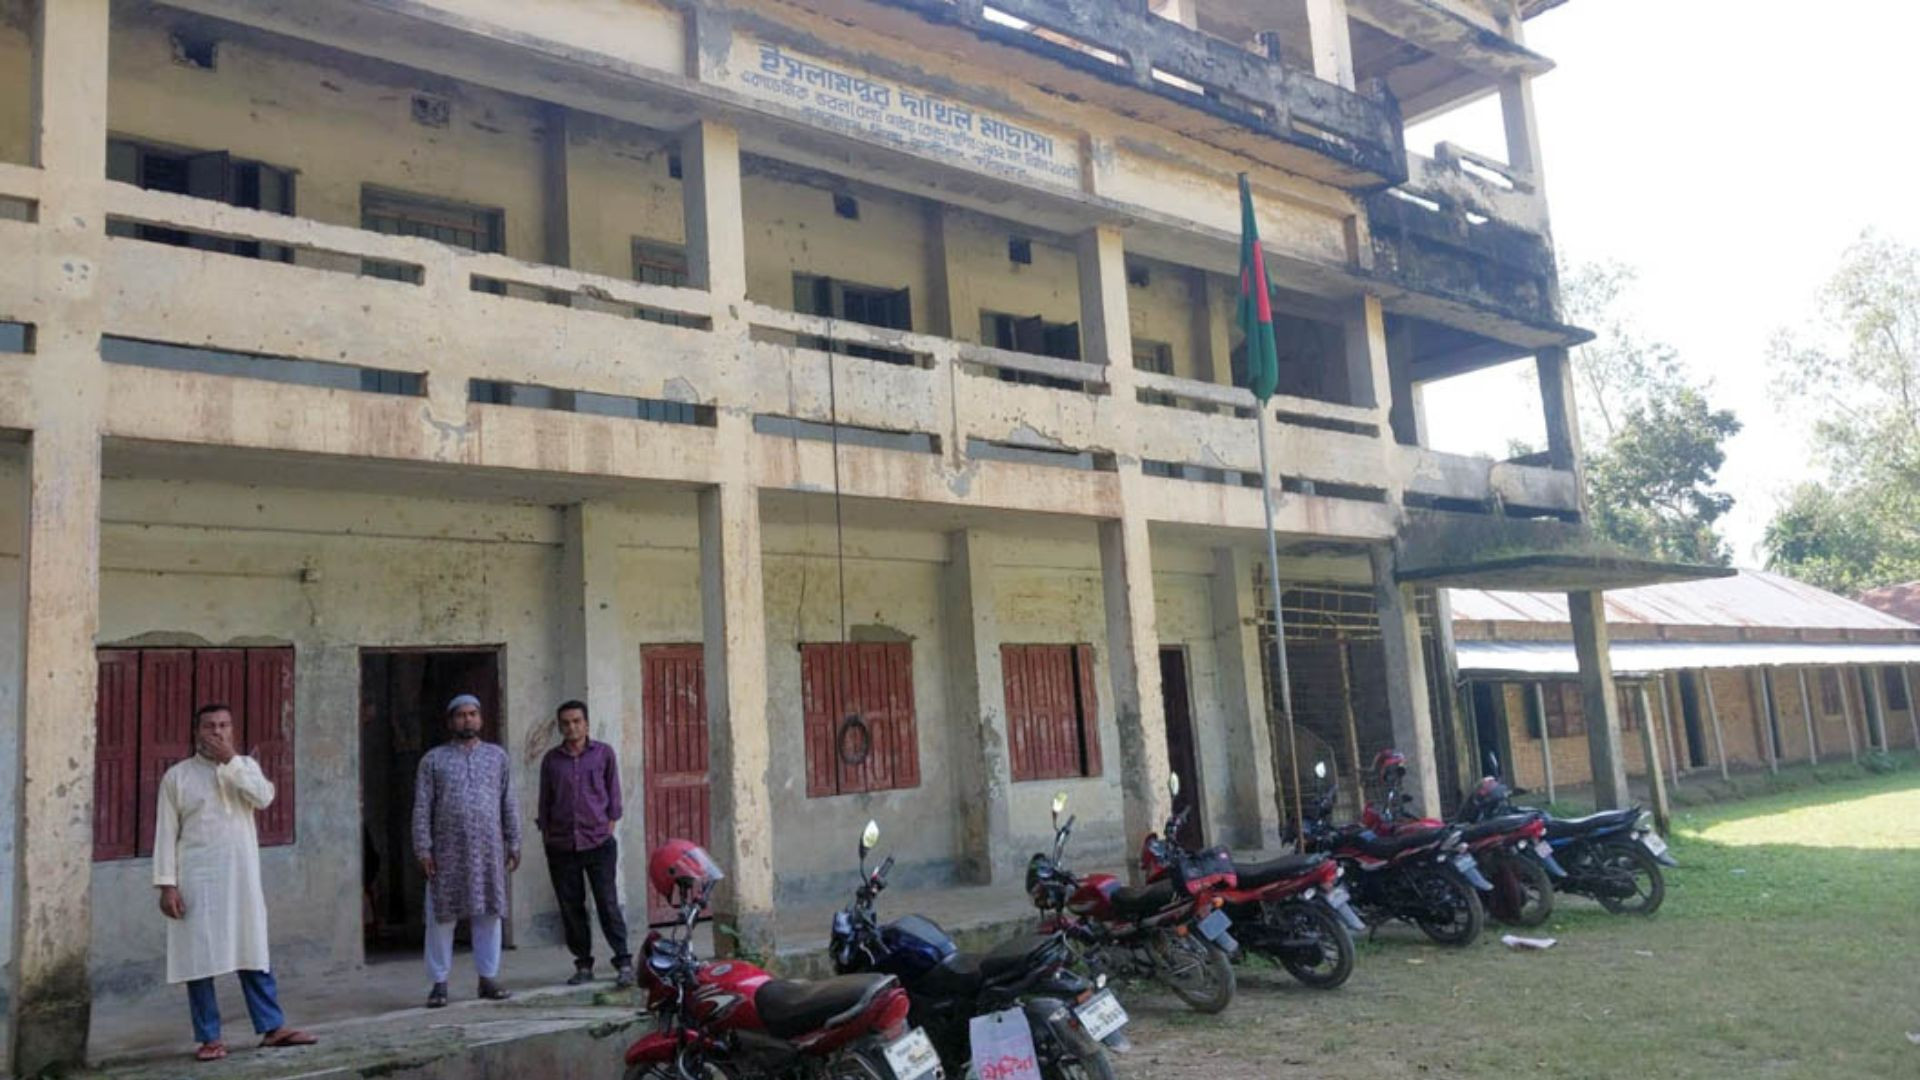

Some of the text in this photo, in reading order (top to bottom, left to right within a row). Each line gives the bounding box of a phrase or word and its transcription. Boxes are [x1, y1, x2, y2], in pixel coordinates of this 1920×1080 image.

[759, 43, 891, 109] ইসলামপুর
[899, 91, 972, 131] দাখিল
[979, 114, 1054, 156] মাদ্রাসা
